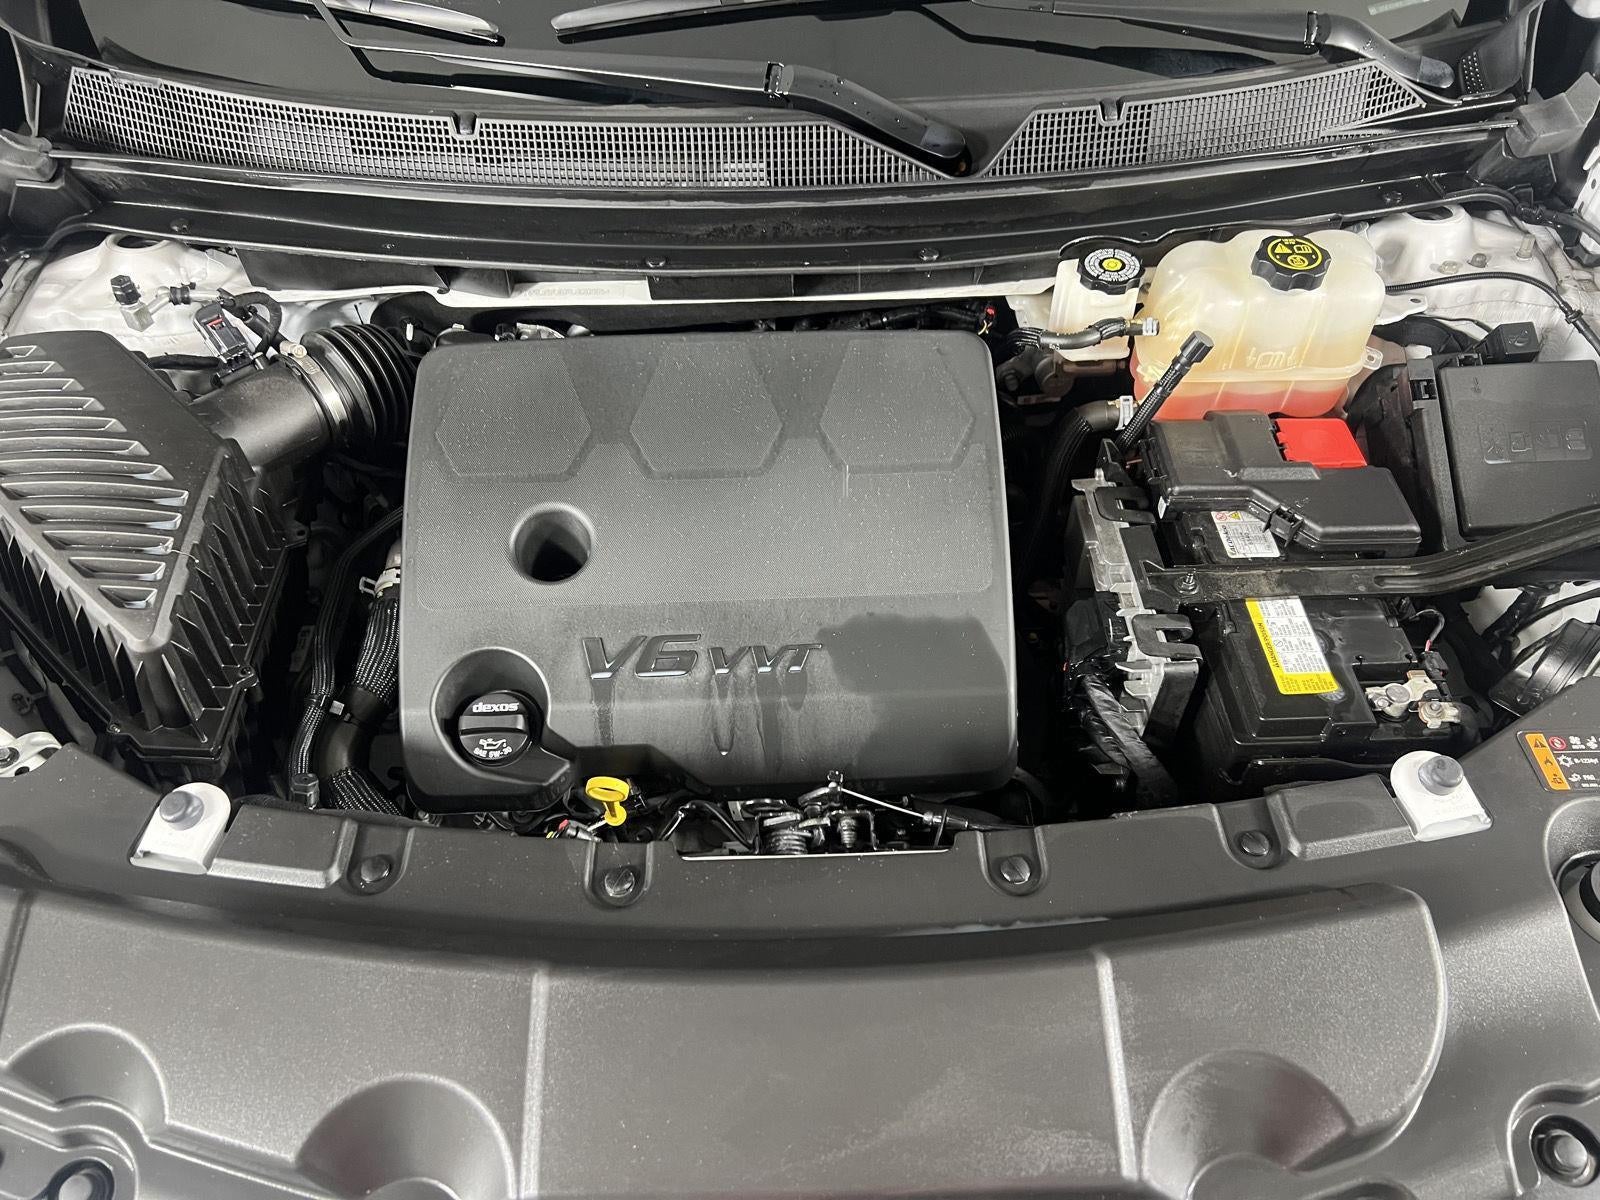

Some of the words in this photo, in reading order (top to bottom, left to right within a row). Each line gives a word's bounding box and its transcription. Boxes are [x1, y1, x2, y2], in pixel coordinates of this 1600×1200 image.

[582, 634, 701, 679] V6
[708, 643, 823, 674] VVT
[472, 702, 520, 713] dexos
